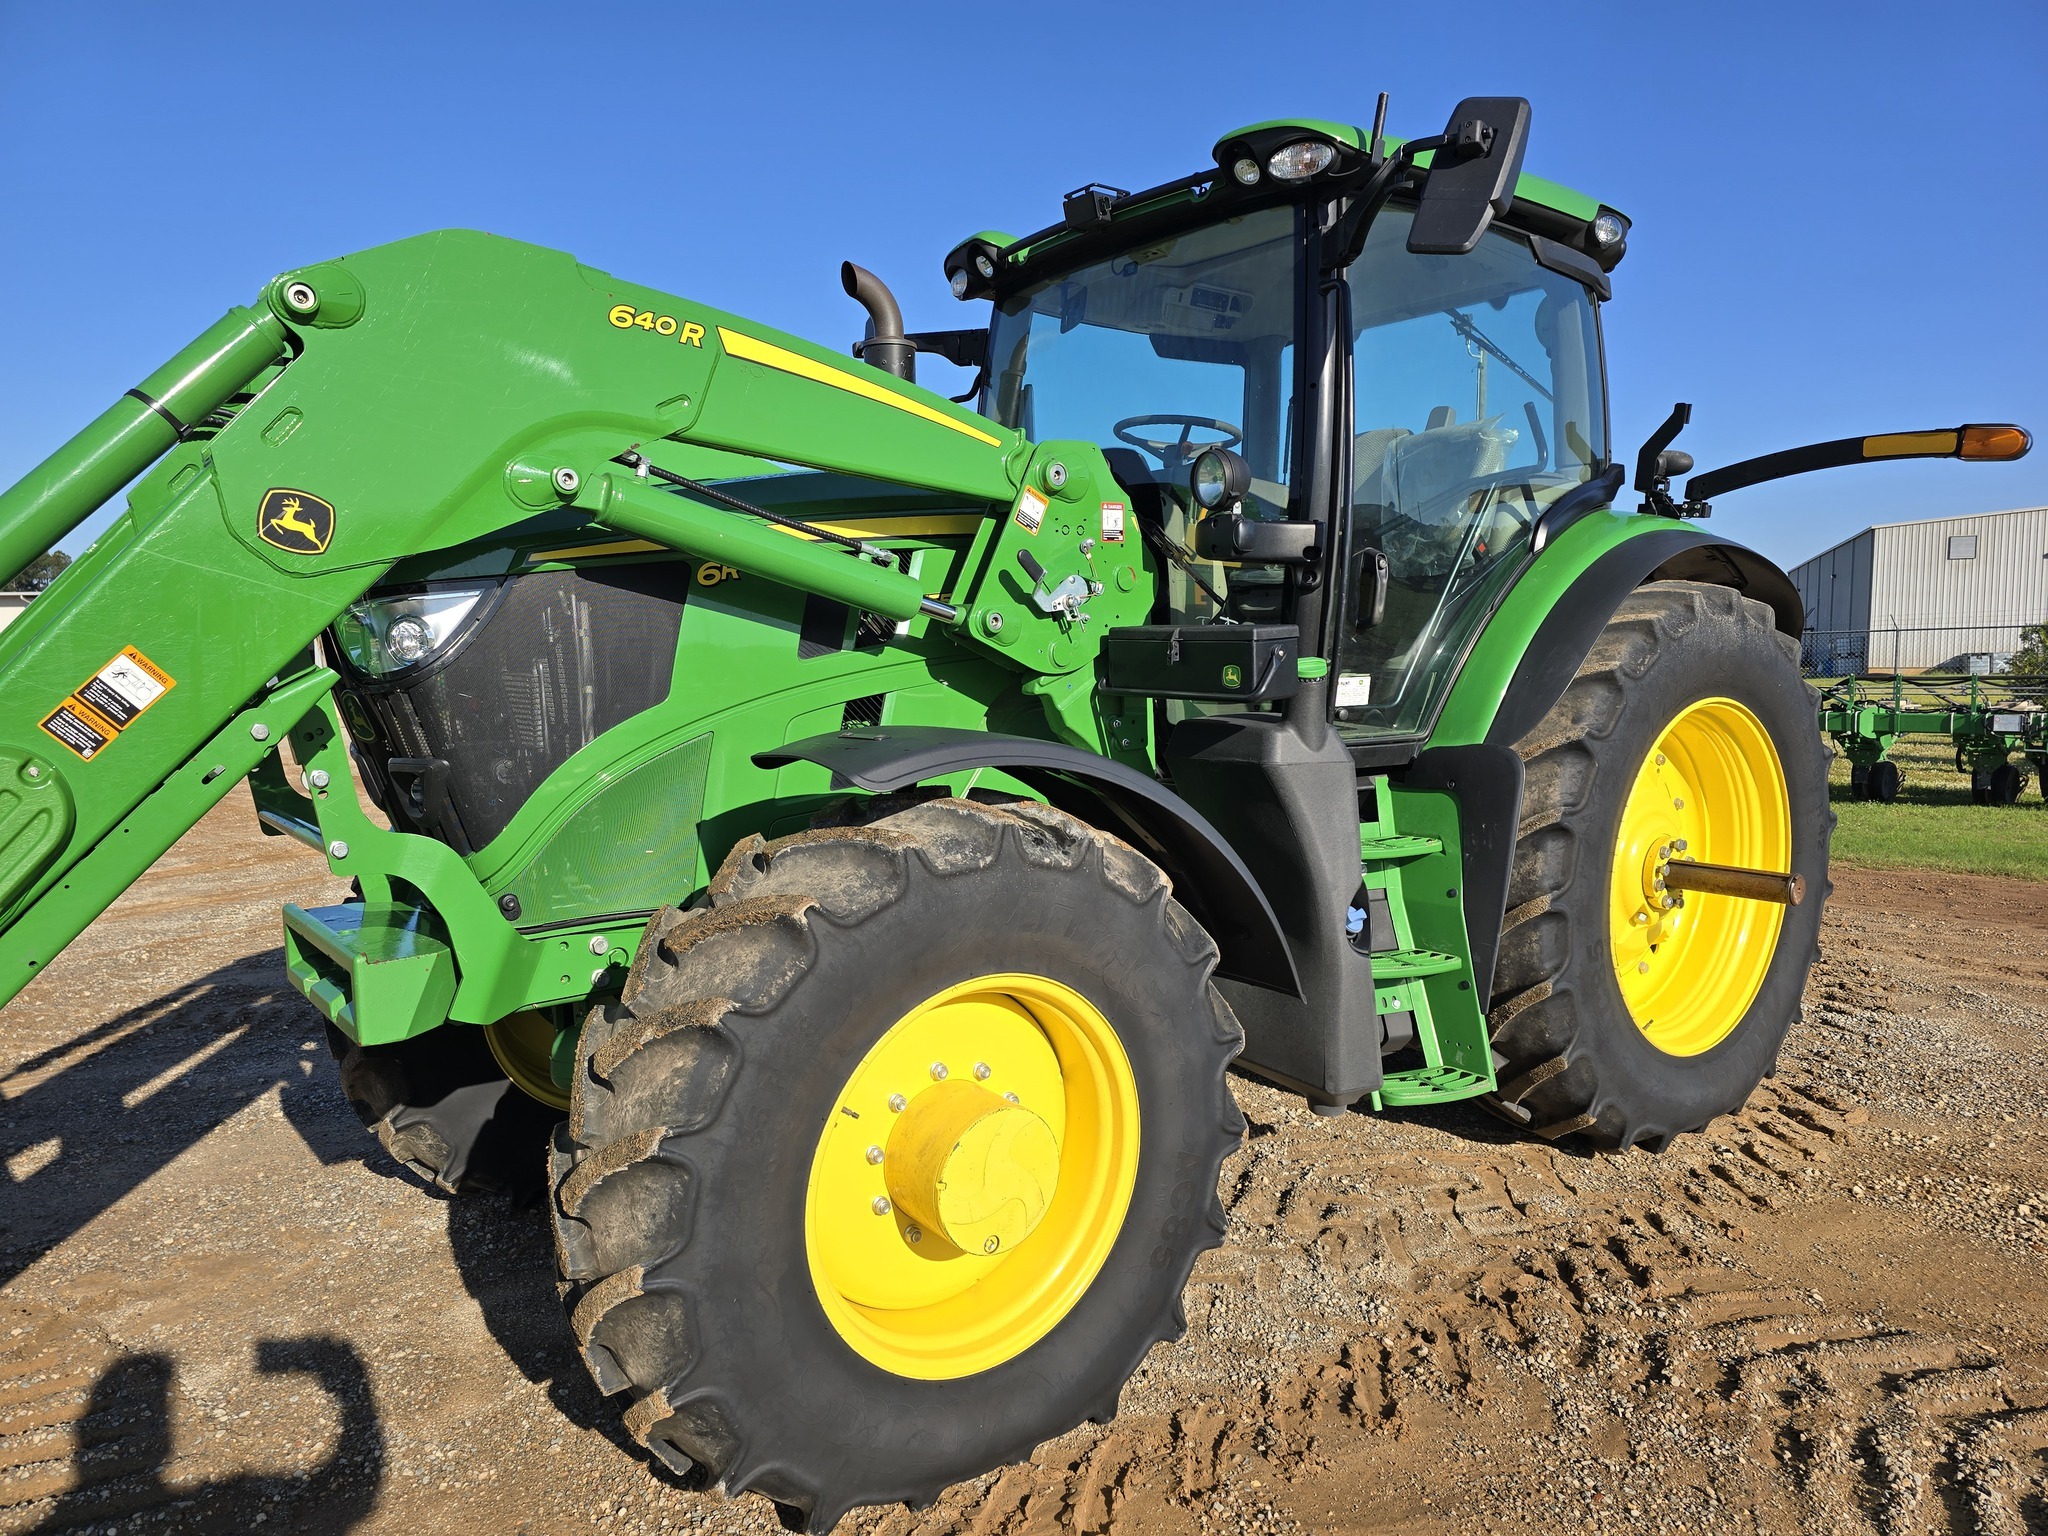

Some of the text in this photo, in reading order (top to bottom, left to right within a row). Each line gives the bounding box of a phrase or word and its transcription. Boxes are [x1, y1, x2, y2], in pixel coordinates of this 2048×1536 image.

[608, 304, 706, 348] 640 R
[137, 657, 169, 685] WARNING
[78, 709, 111, 736] WARNING
